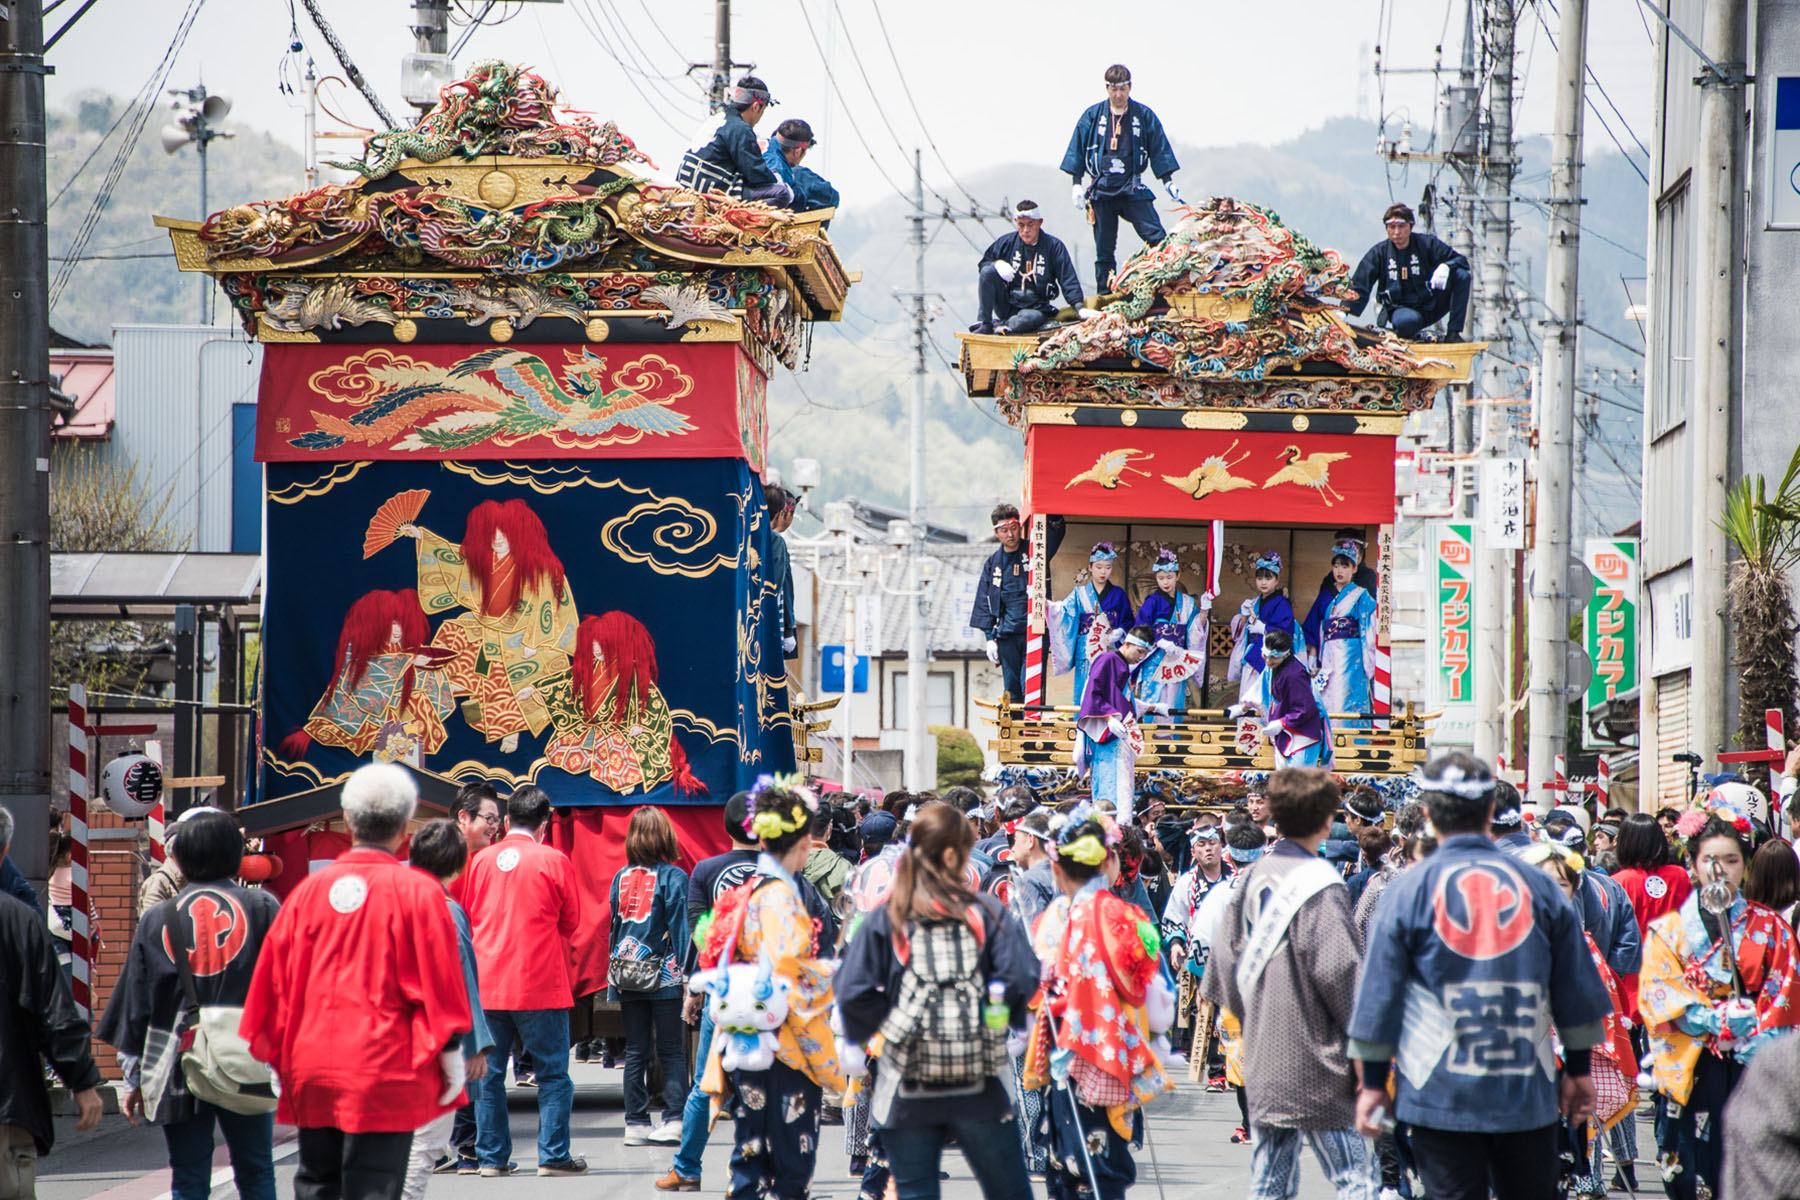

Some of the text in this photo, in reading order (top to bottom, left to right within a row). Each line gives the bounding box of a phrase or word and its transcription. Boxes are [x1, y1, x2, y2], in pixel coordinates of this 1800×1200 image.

[1443, 581, 1469, 698] フジカラー
